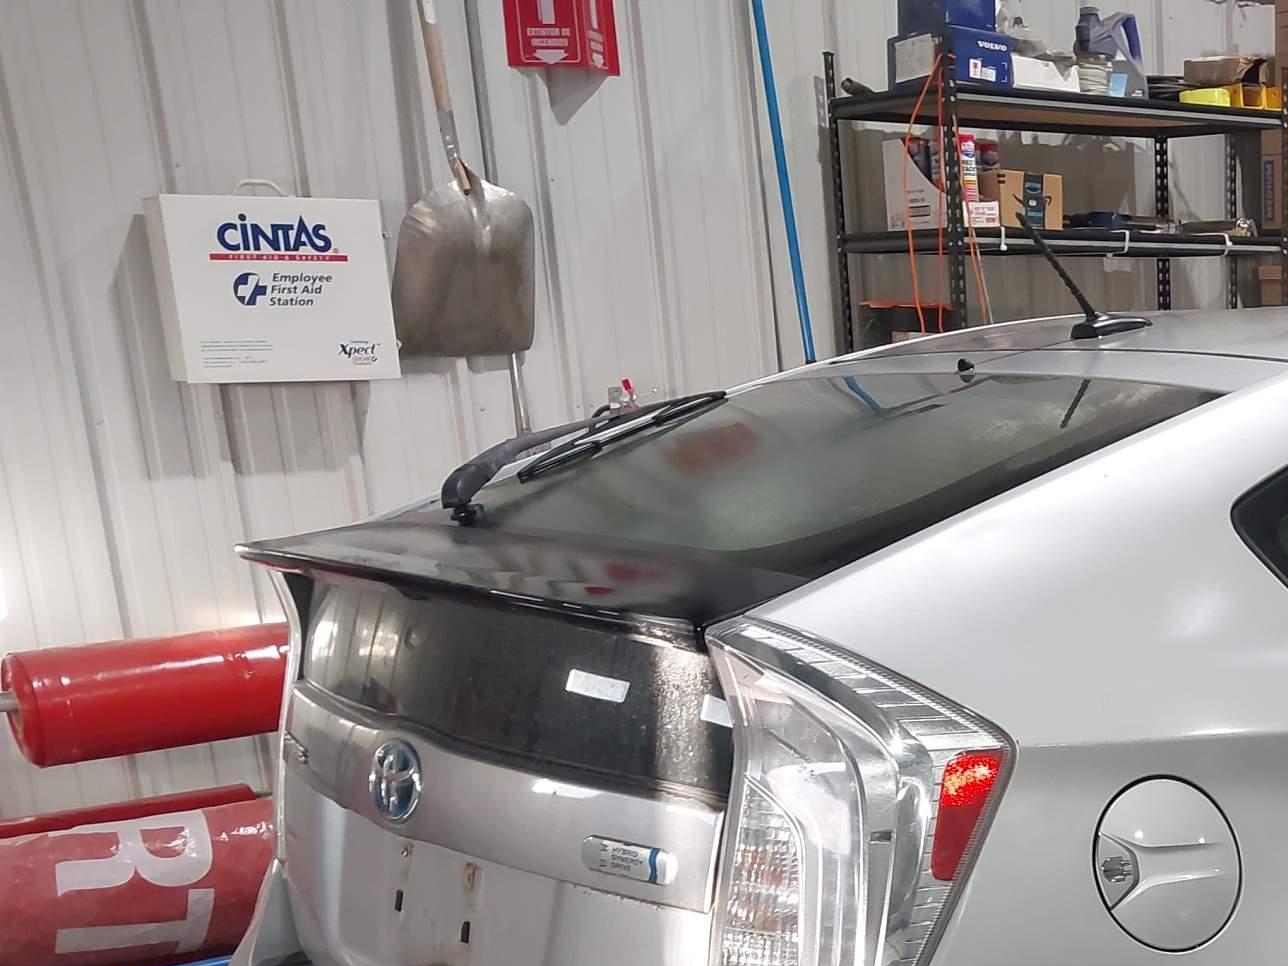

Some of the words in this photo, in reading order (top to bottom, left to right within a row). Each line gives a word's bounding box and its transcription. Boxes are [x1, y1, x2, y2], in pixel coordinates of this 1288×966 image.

[977, 40, 1008, 52] VOLVO
[1264, 163, 1274, 219] MEDIUM
[217, 213, 332, 253] CINTAS
[272, 272, 333, 285] Employee
[271, 284, 298, 295] First
[301, 285, 323, 295] Aid
[269, 297, 314, 307] Station
[338, 343, 376, 359] Xpect
[611, 846, 639, 858] HYBRID
[610, 854, 644, 867] SYNERGY
[610, 861, 632, 872] DRIVE
